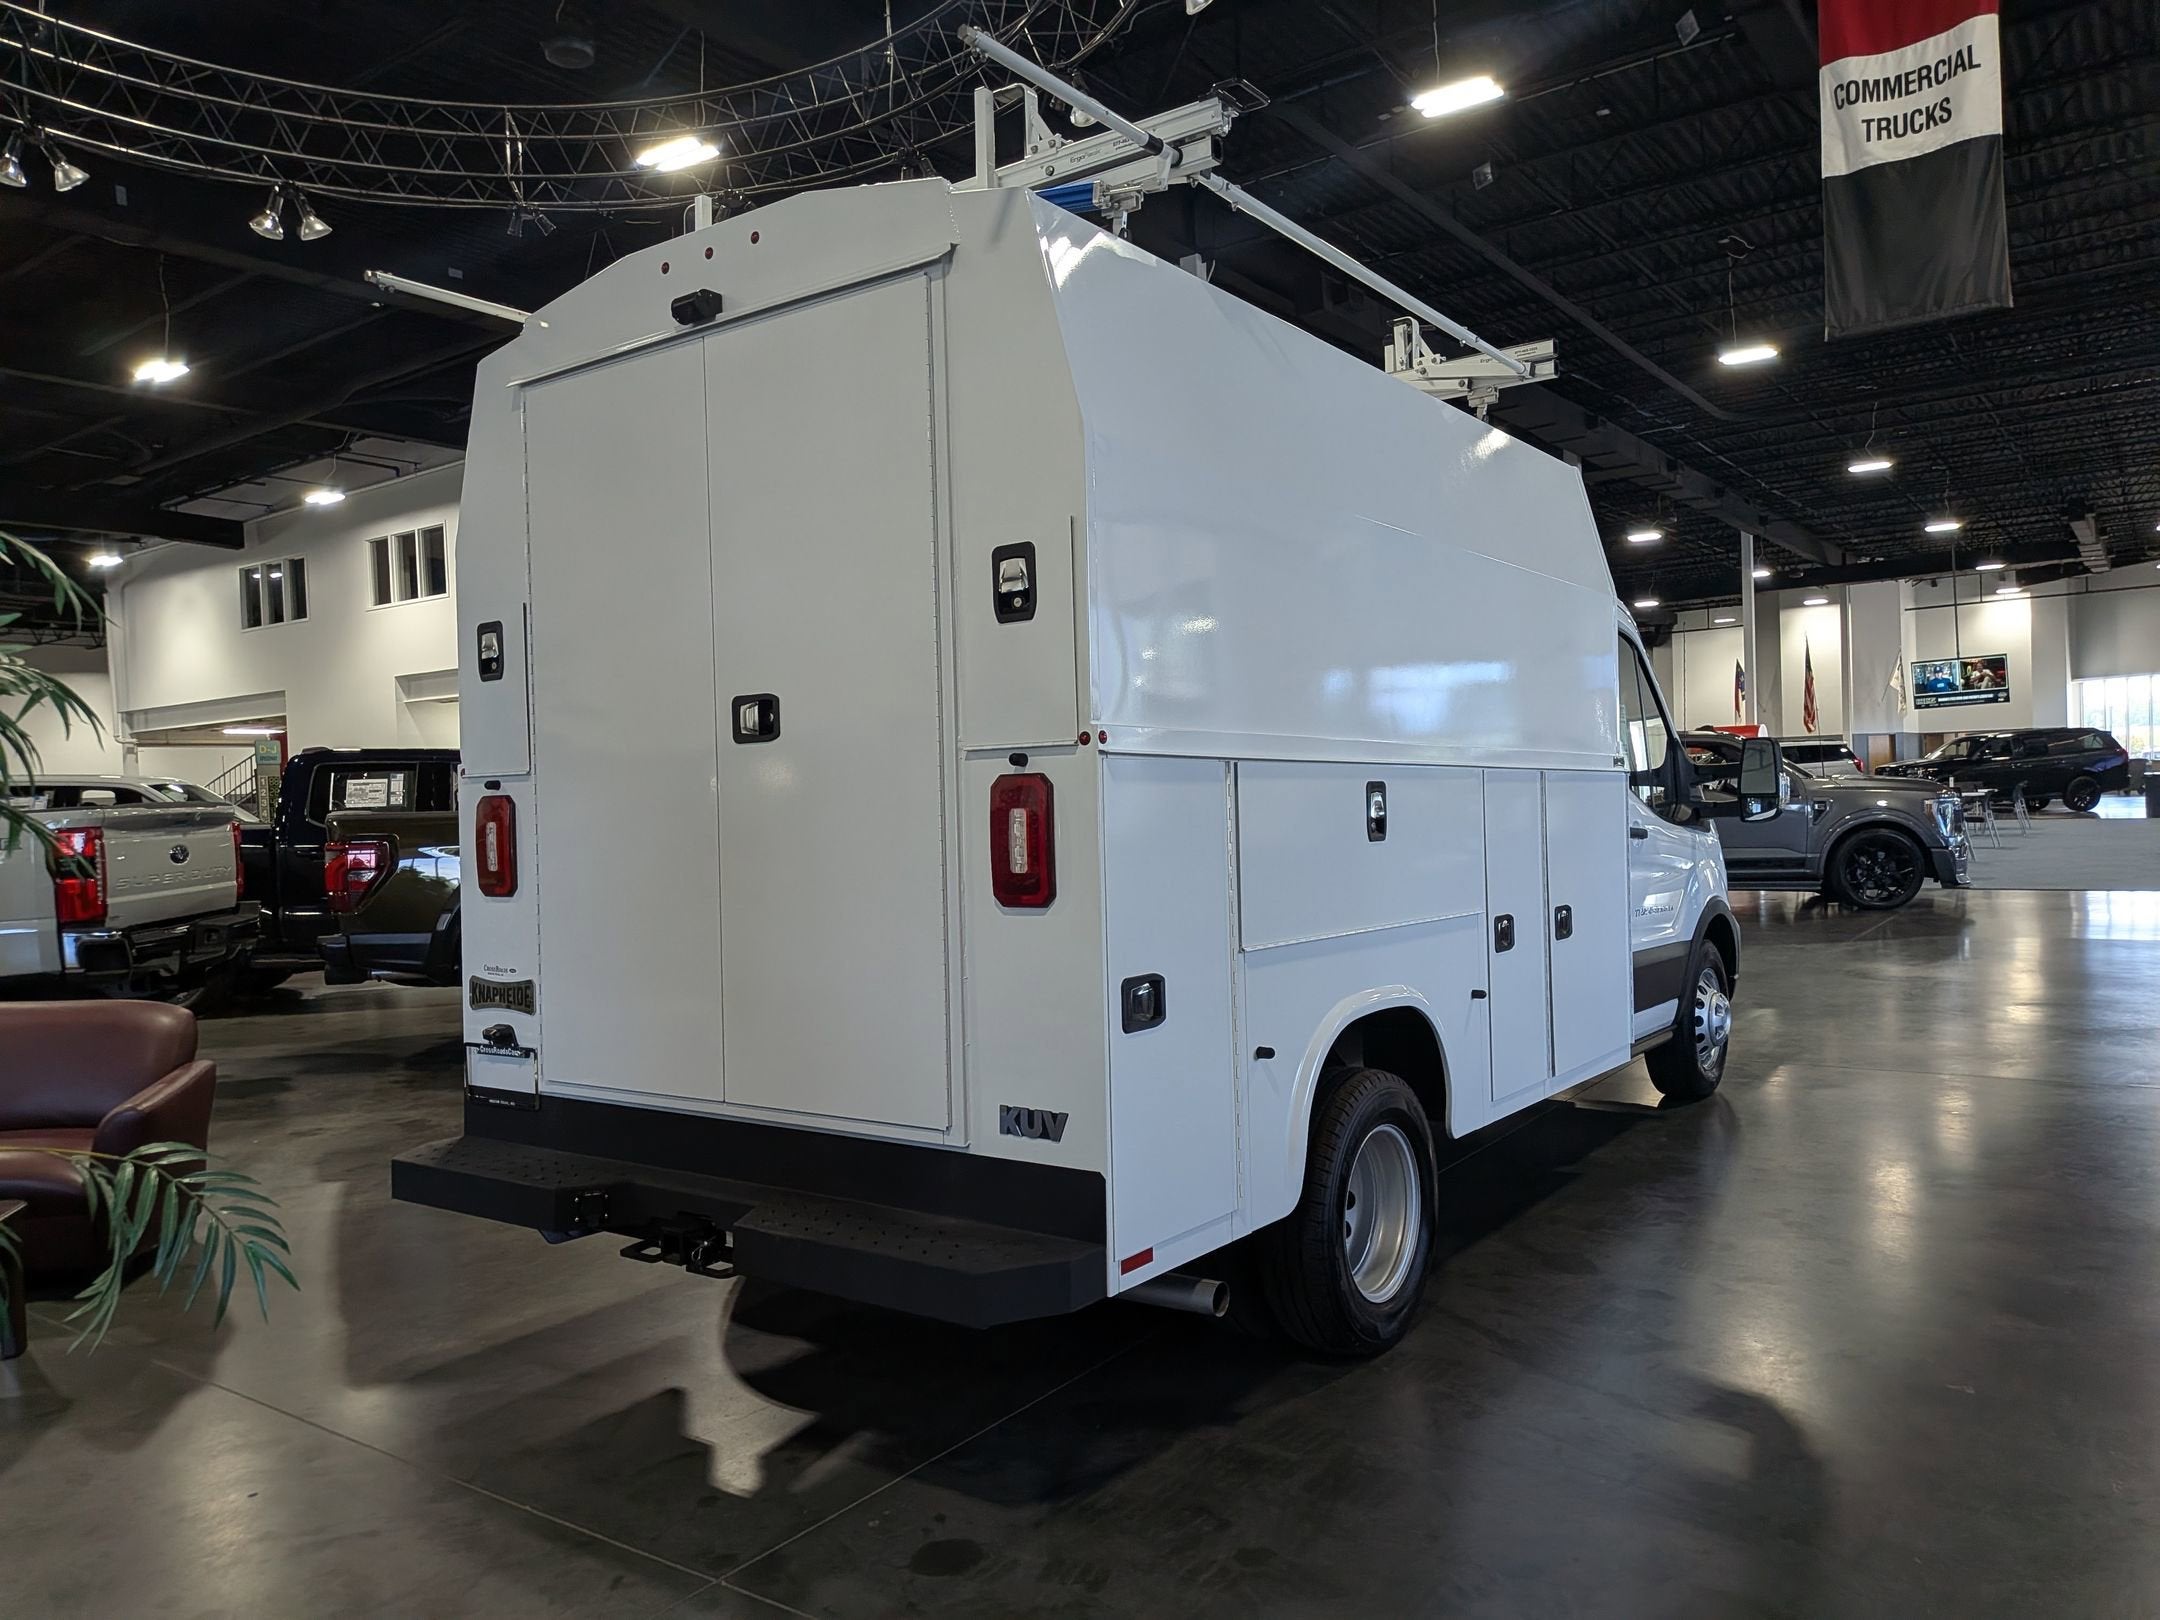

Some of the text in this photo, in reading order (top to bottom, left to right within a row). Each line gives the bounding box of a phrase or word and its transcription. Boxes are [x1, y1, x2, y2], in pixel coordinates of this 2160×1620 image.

[1833, 44, 1981, 110] COMMERCIAL
[1861, 96, 1952, 142] TRUCKS
[116, 871, 187, 889] SUPER
[471, 981, 532, 1009] KNAPHEIDE
[999, 1104, 1069, 1143] KUV
